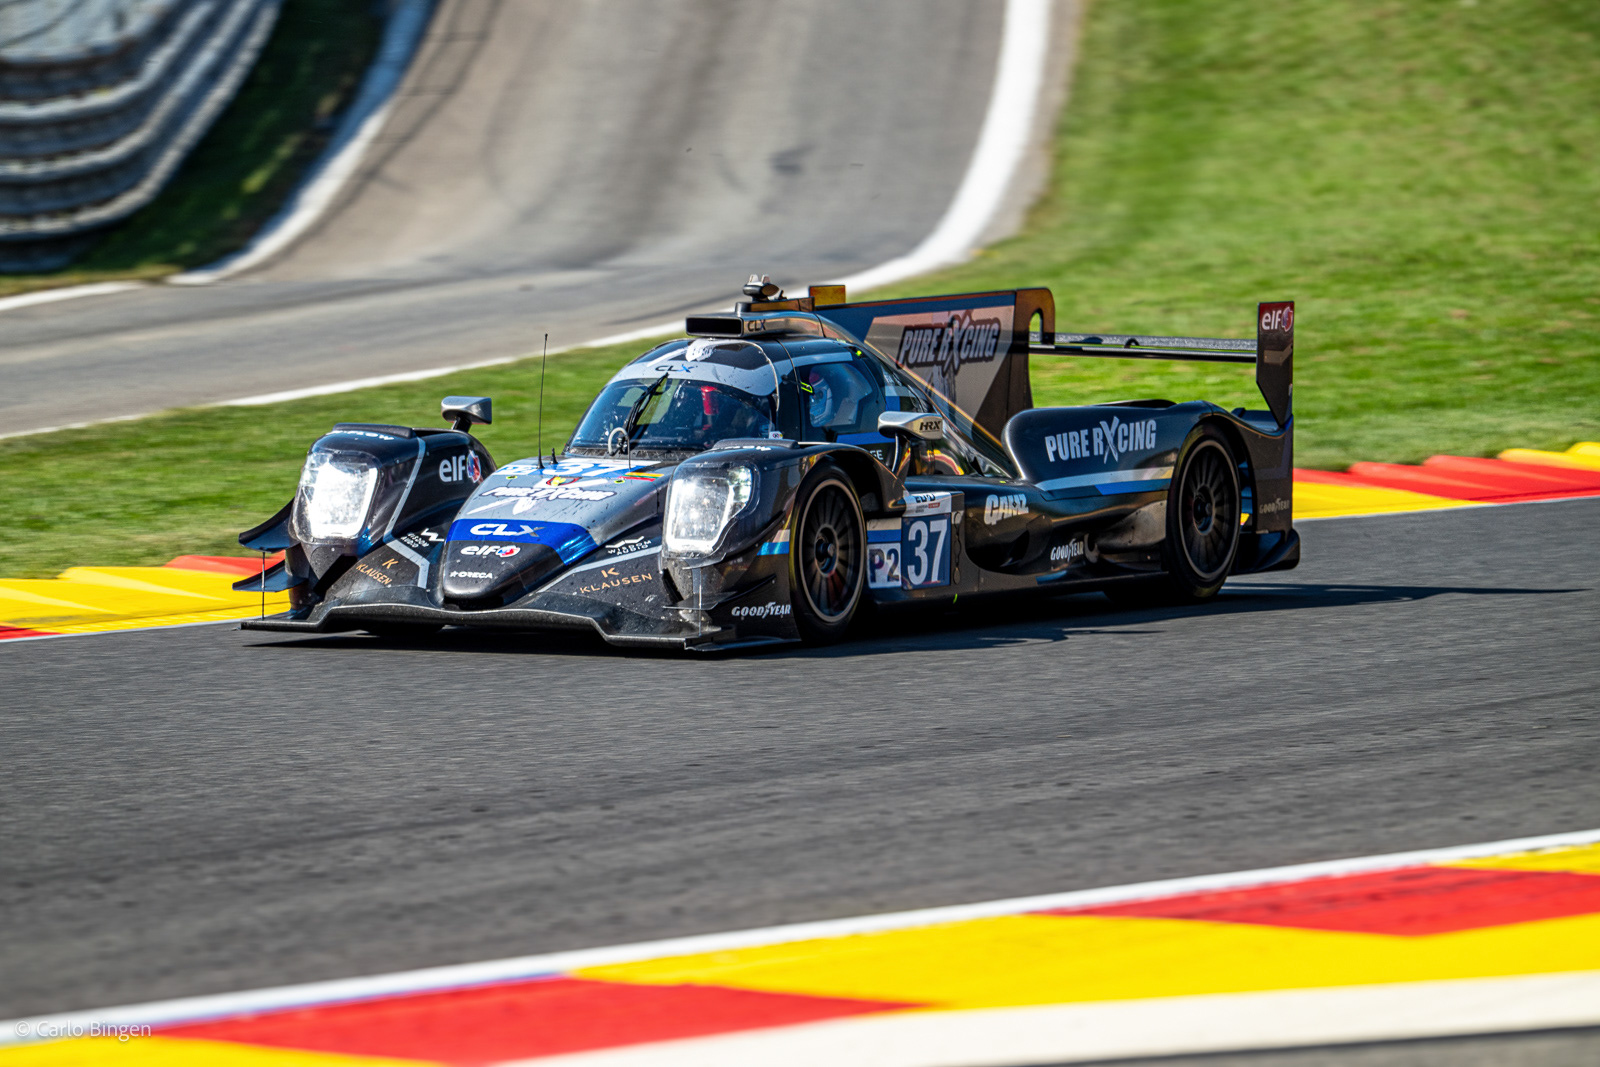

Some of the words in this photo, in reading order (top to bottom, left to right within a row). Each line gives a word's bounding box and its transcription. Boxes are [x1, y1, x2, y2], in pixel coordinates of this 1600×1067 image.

[747, 319, 766, 332] CLX
[1262, 309, 1282, 330] elf
[898, 328, 942, 364] PURE
[655, 364, 695, 373] CLX
[919, 421, 941, 431] HRX
[1045, 429, 1090, 462] PURE
[438, 455, 466, 483] elf
[542, 462, 637, 477] 37
[470, 523, 546, 538] CLX
[460, 545, 501, 556] elf
[907, 519, 948, 585] 37
[1050, 538, 1084, 562] GOODYEAR
[356, 564, 393, 585] KLAUSEN
[458, 571, 493, 580] ORECA
[868, 548, 900, 583] P2
[579, 573, 653, 594] KLAUSEN
[731, 601, 792, 619] GOODYEAR
